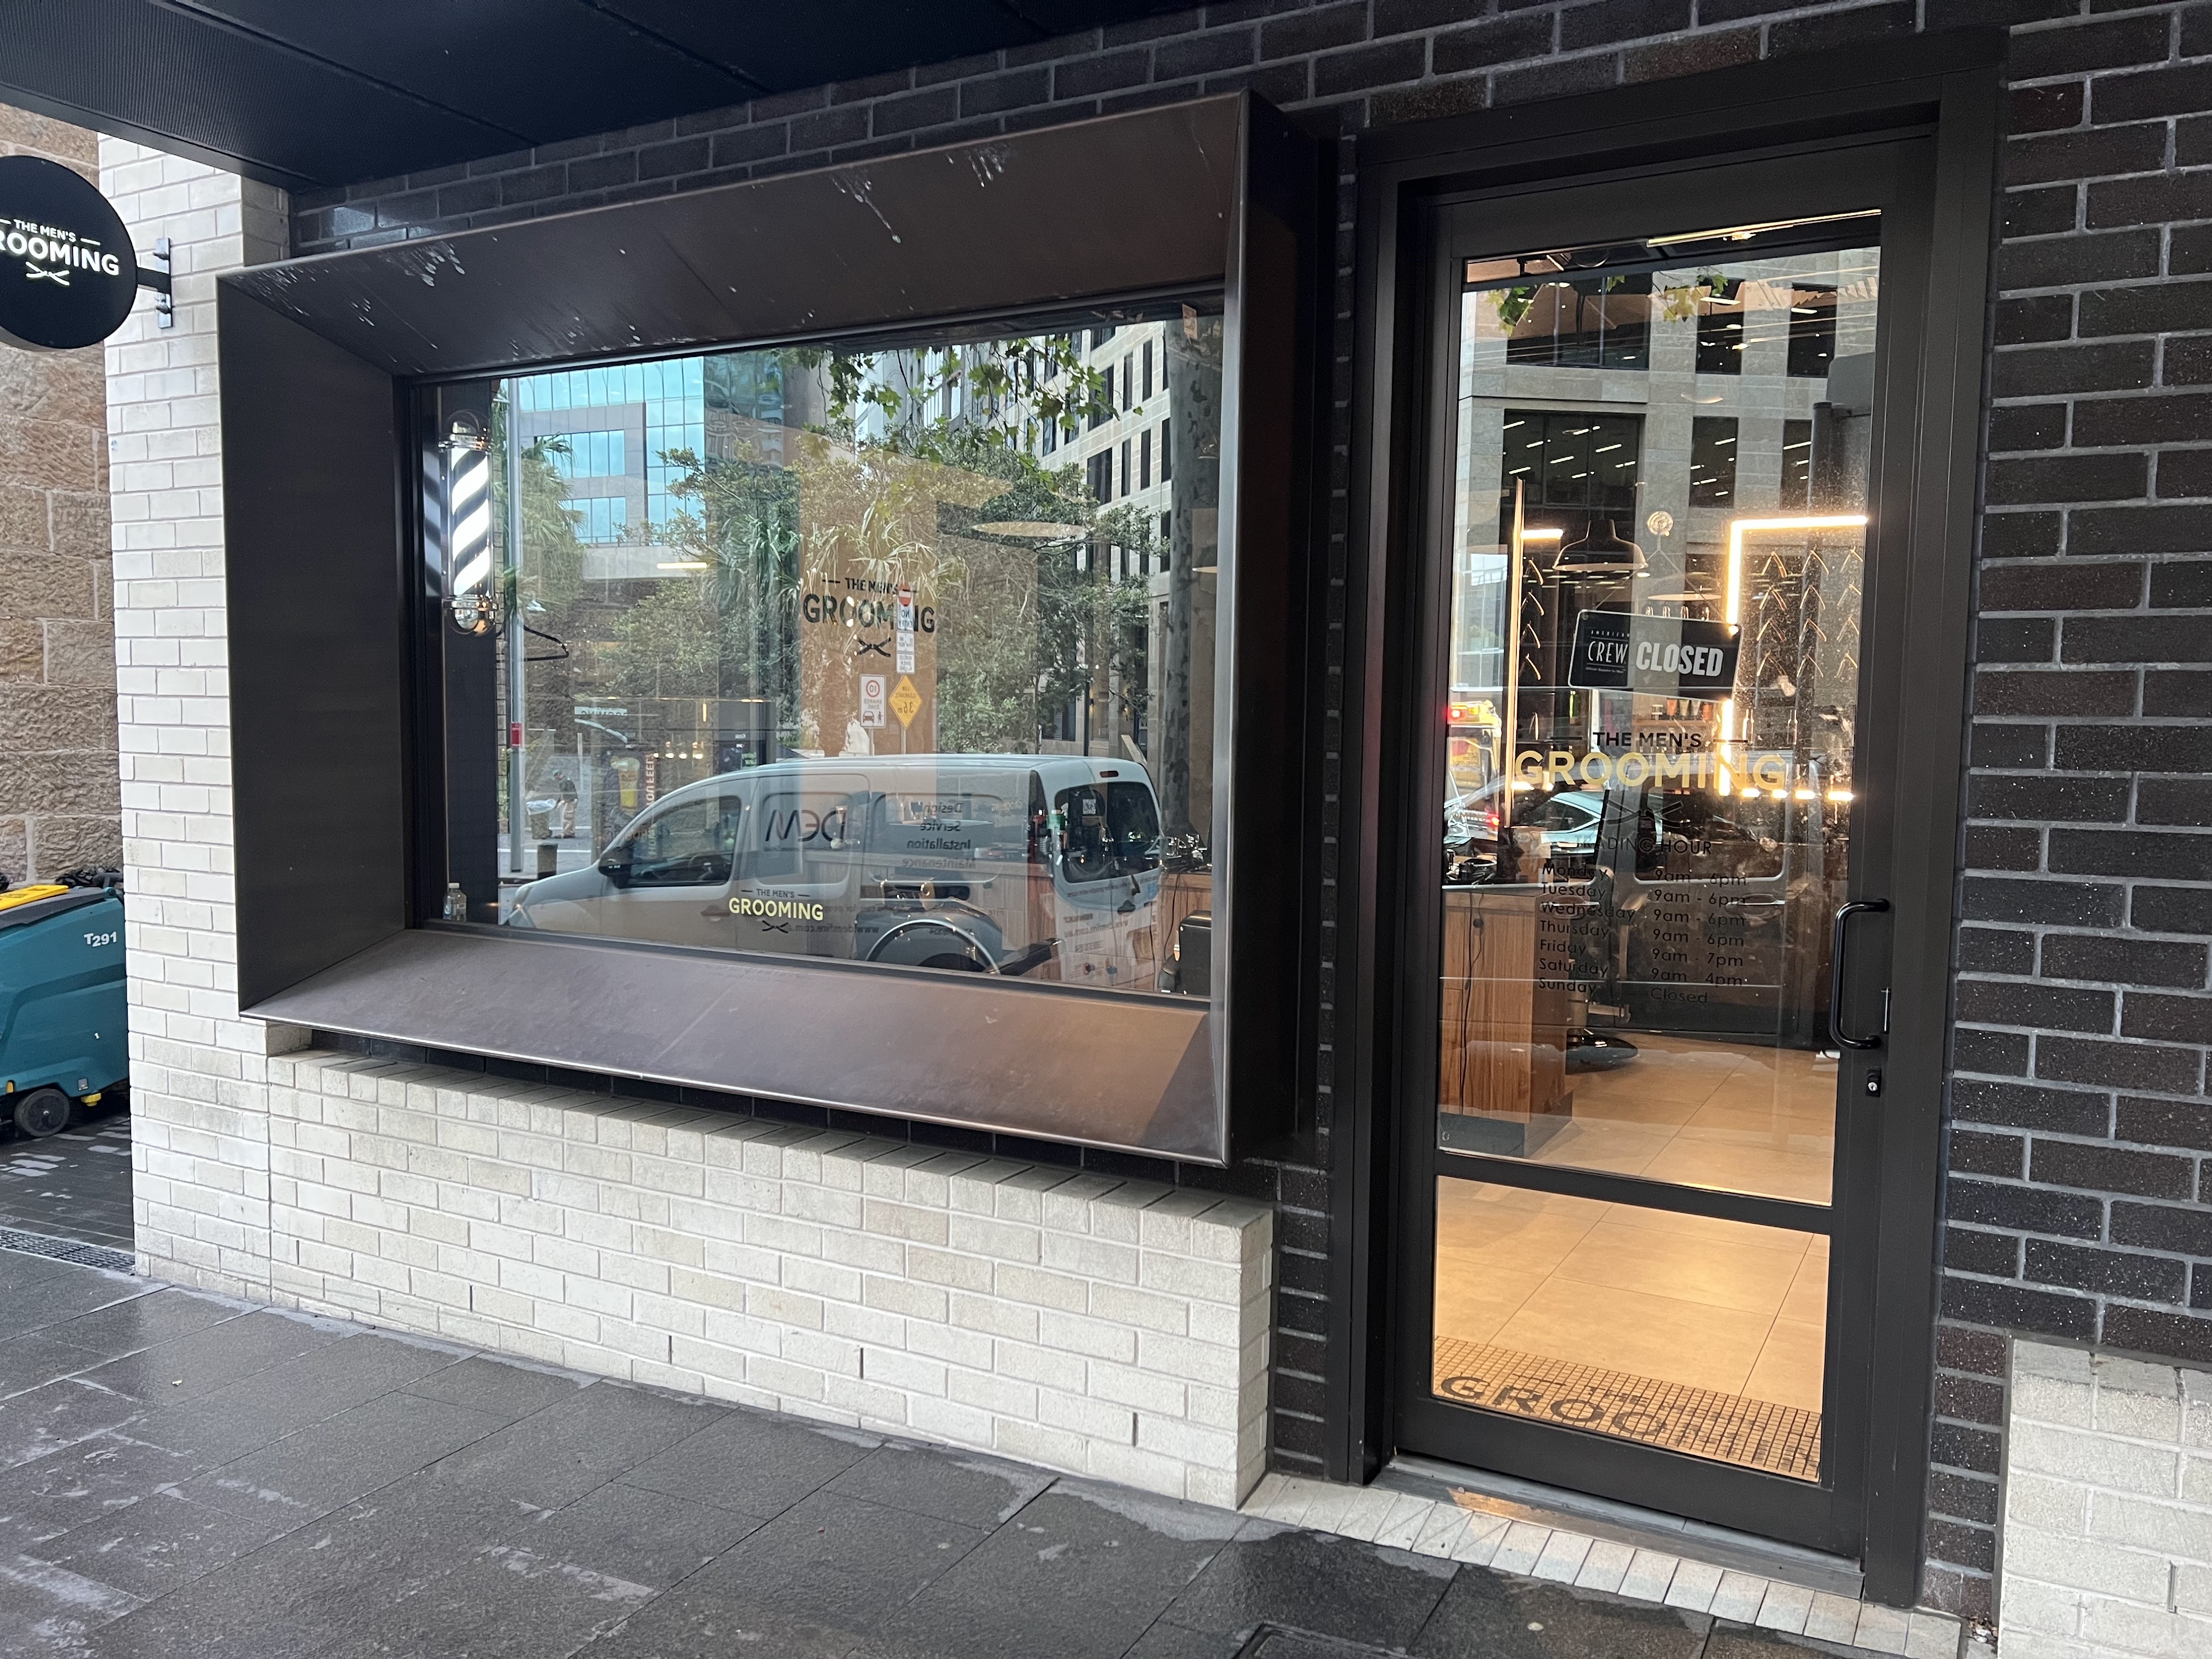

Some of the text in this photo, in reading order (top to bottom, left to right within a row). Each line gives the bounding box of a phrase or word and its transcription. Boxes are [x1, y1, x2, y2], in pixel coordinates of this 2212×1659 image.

[13, 219, 76, 243] THE MEN'S
[845, 578, 865, 591] THE
[803, 593, 935, 633] GROOMG
[1588, 640, 1724, 677] CREW CLOSED
[1593, 732, 1703, 748] THE MEN'S
[1515, 750, 1786, 791] GROOMING
[1575, 836, 1712, 854] TRADING HOUR
[1542, 863, 1608, 880] Monday
[1655, 869, 1691, 883] 9am
[1709, 872, 1747, 888] 6pm
[756, 888, 795, 899] THE MEN'S
[1542, 882, 1606, 898] Tuesday
[1654, 889, 1690, 903] 9am
[1709, 893, 1746, 909] 6pm
[728, 897, 824, 921] GROOMING
[1541, 901, 1636, 922] Wednesday
[1653, 908, 1689, 923] 9am
[1708, 913, 1745, 928] 6pm
[84, 931, 118, 948] T291
[1540, 920, 1610, 940] Thursday
[1653, 928, 1688, 943] 9am
[1707, 932, 1744, 948] 6pm
[1540, 939, 1587, 956] Friday
[1652, 948, 1687, 963] 9am
[1707, 952, 1743, 968] 7pm
[1539, 958, 1608, 978] Saturday
[1651, 968, 1687, 982] 9am
[1705, 973, 1742, 988] 4pm
[1538, 977, 1708, 1004] Sunday Closed
